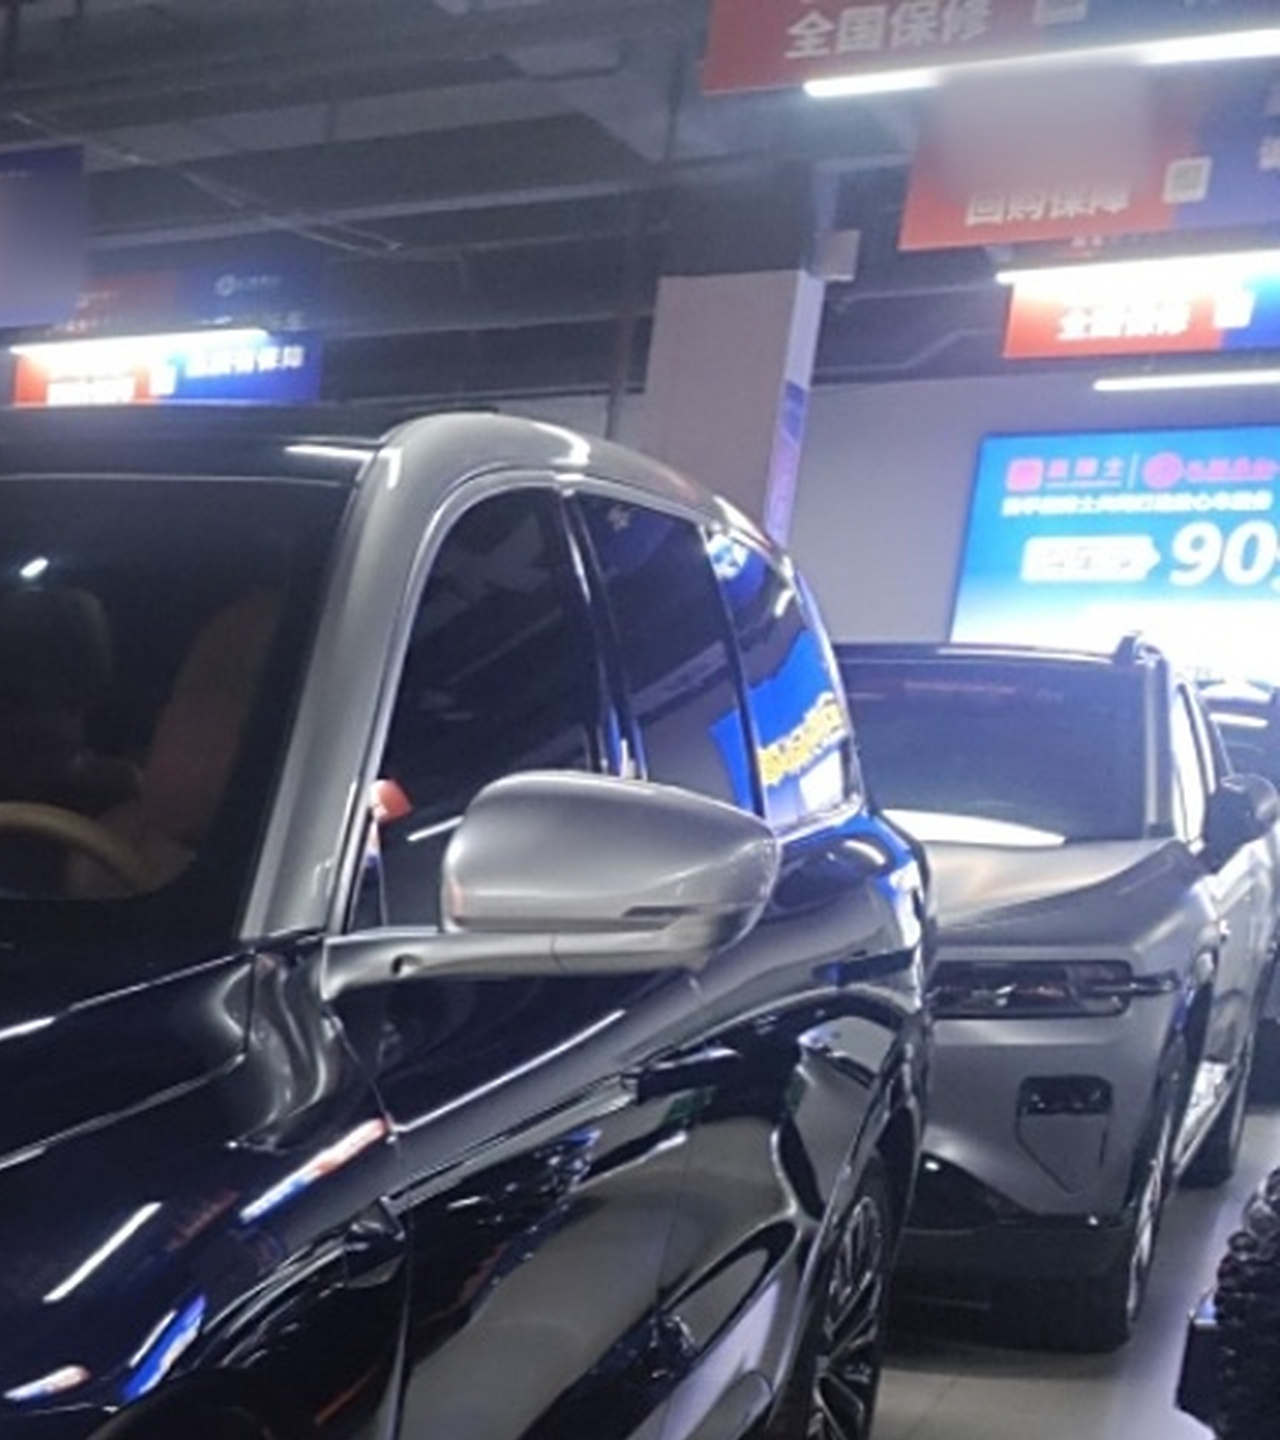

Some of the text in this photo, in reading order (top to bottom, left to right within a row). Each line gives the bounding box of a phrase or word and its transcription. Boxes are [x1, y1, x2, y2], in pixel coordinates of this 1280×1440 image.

[785, 0, 991, 58] 全国保修
[1169, 519, 1280, 592] 90
